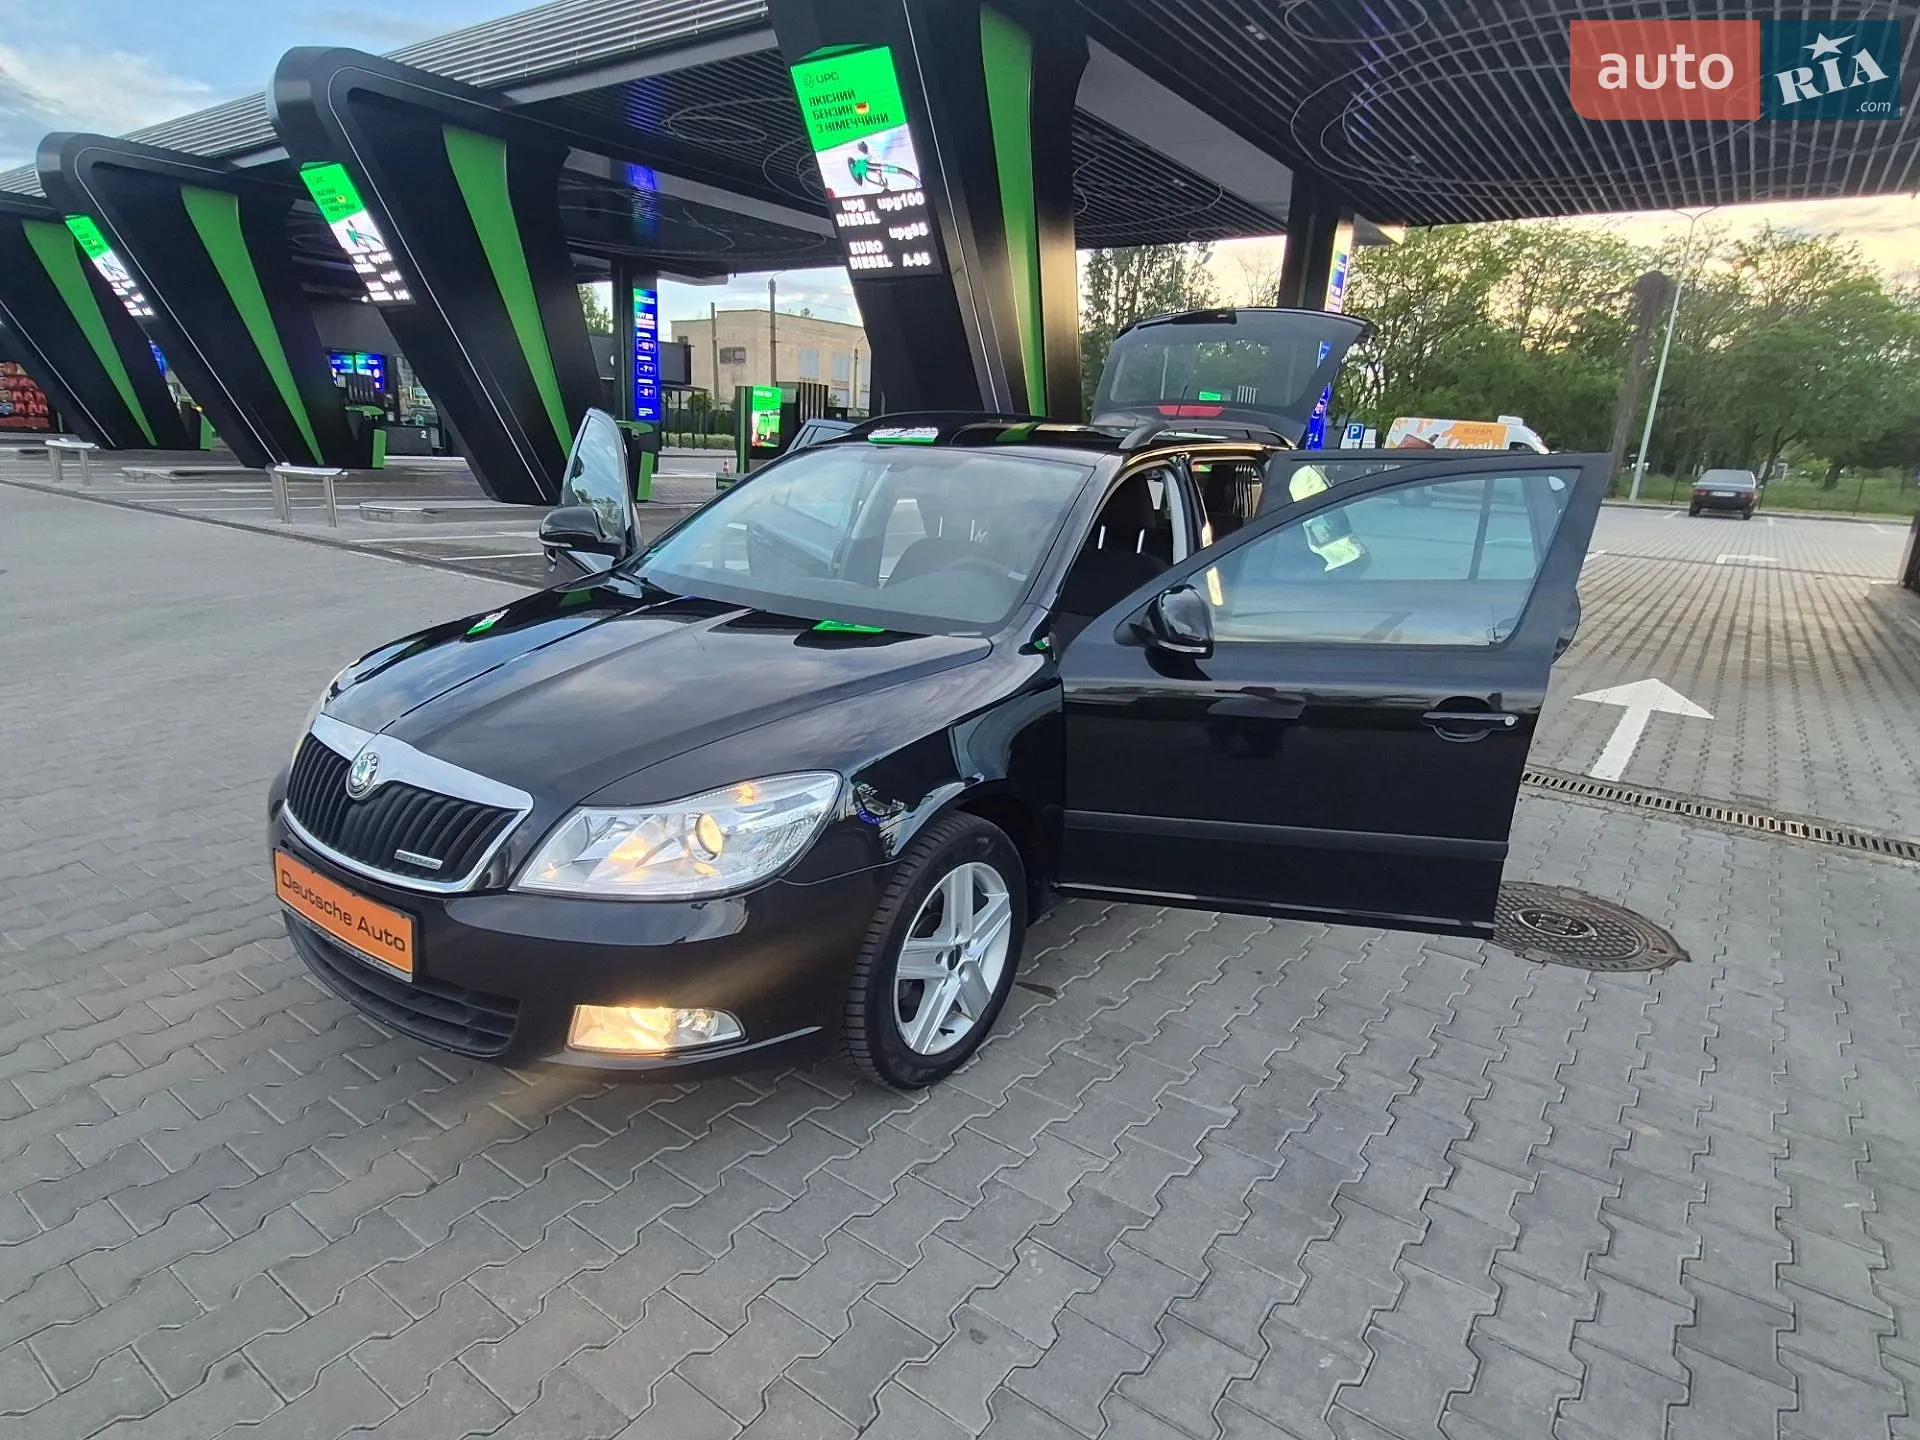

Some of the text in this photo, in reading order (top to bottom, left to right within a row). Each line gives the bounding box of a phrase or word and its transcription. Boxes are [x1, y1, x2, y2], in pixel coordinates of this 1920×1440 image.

[815, 72, 839, 84] UPG
[813, 105, 854, 120] БЕНЗИН
[842, 198, 866, 212] upg
[877, 192, 925, 211] upg100
[836, 211, 880, 227] DIESEL
[849, 240, 883, 255] EURO
[849, 254, 893, 270] DIESEL
[420, 430, 428, 439] 2
[1350, 426, 1359, 437] P
[281, 870, 352, 926] Deutsche
[357, 916, 406, 952] Auto
